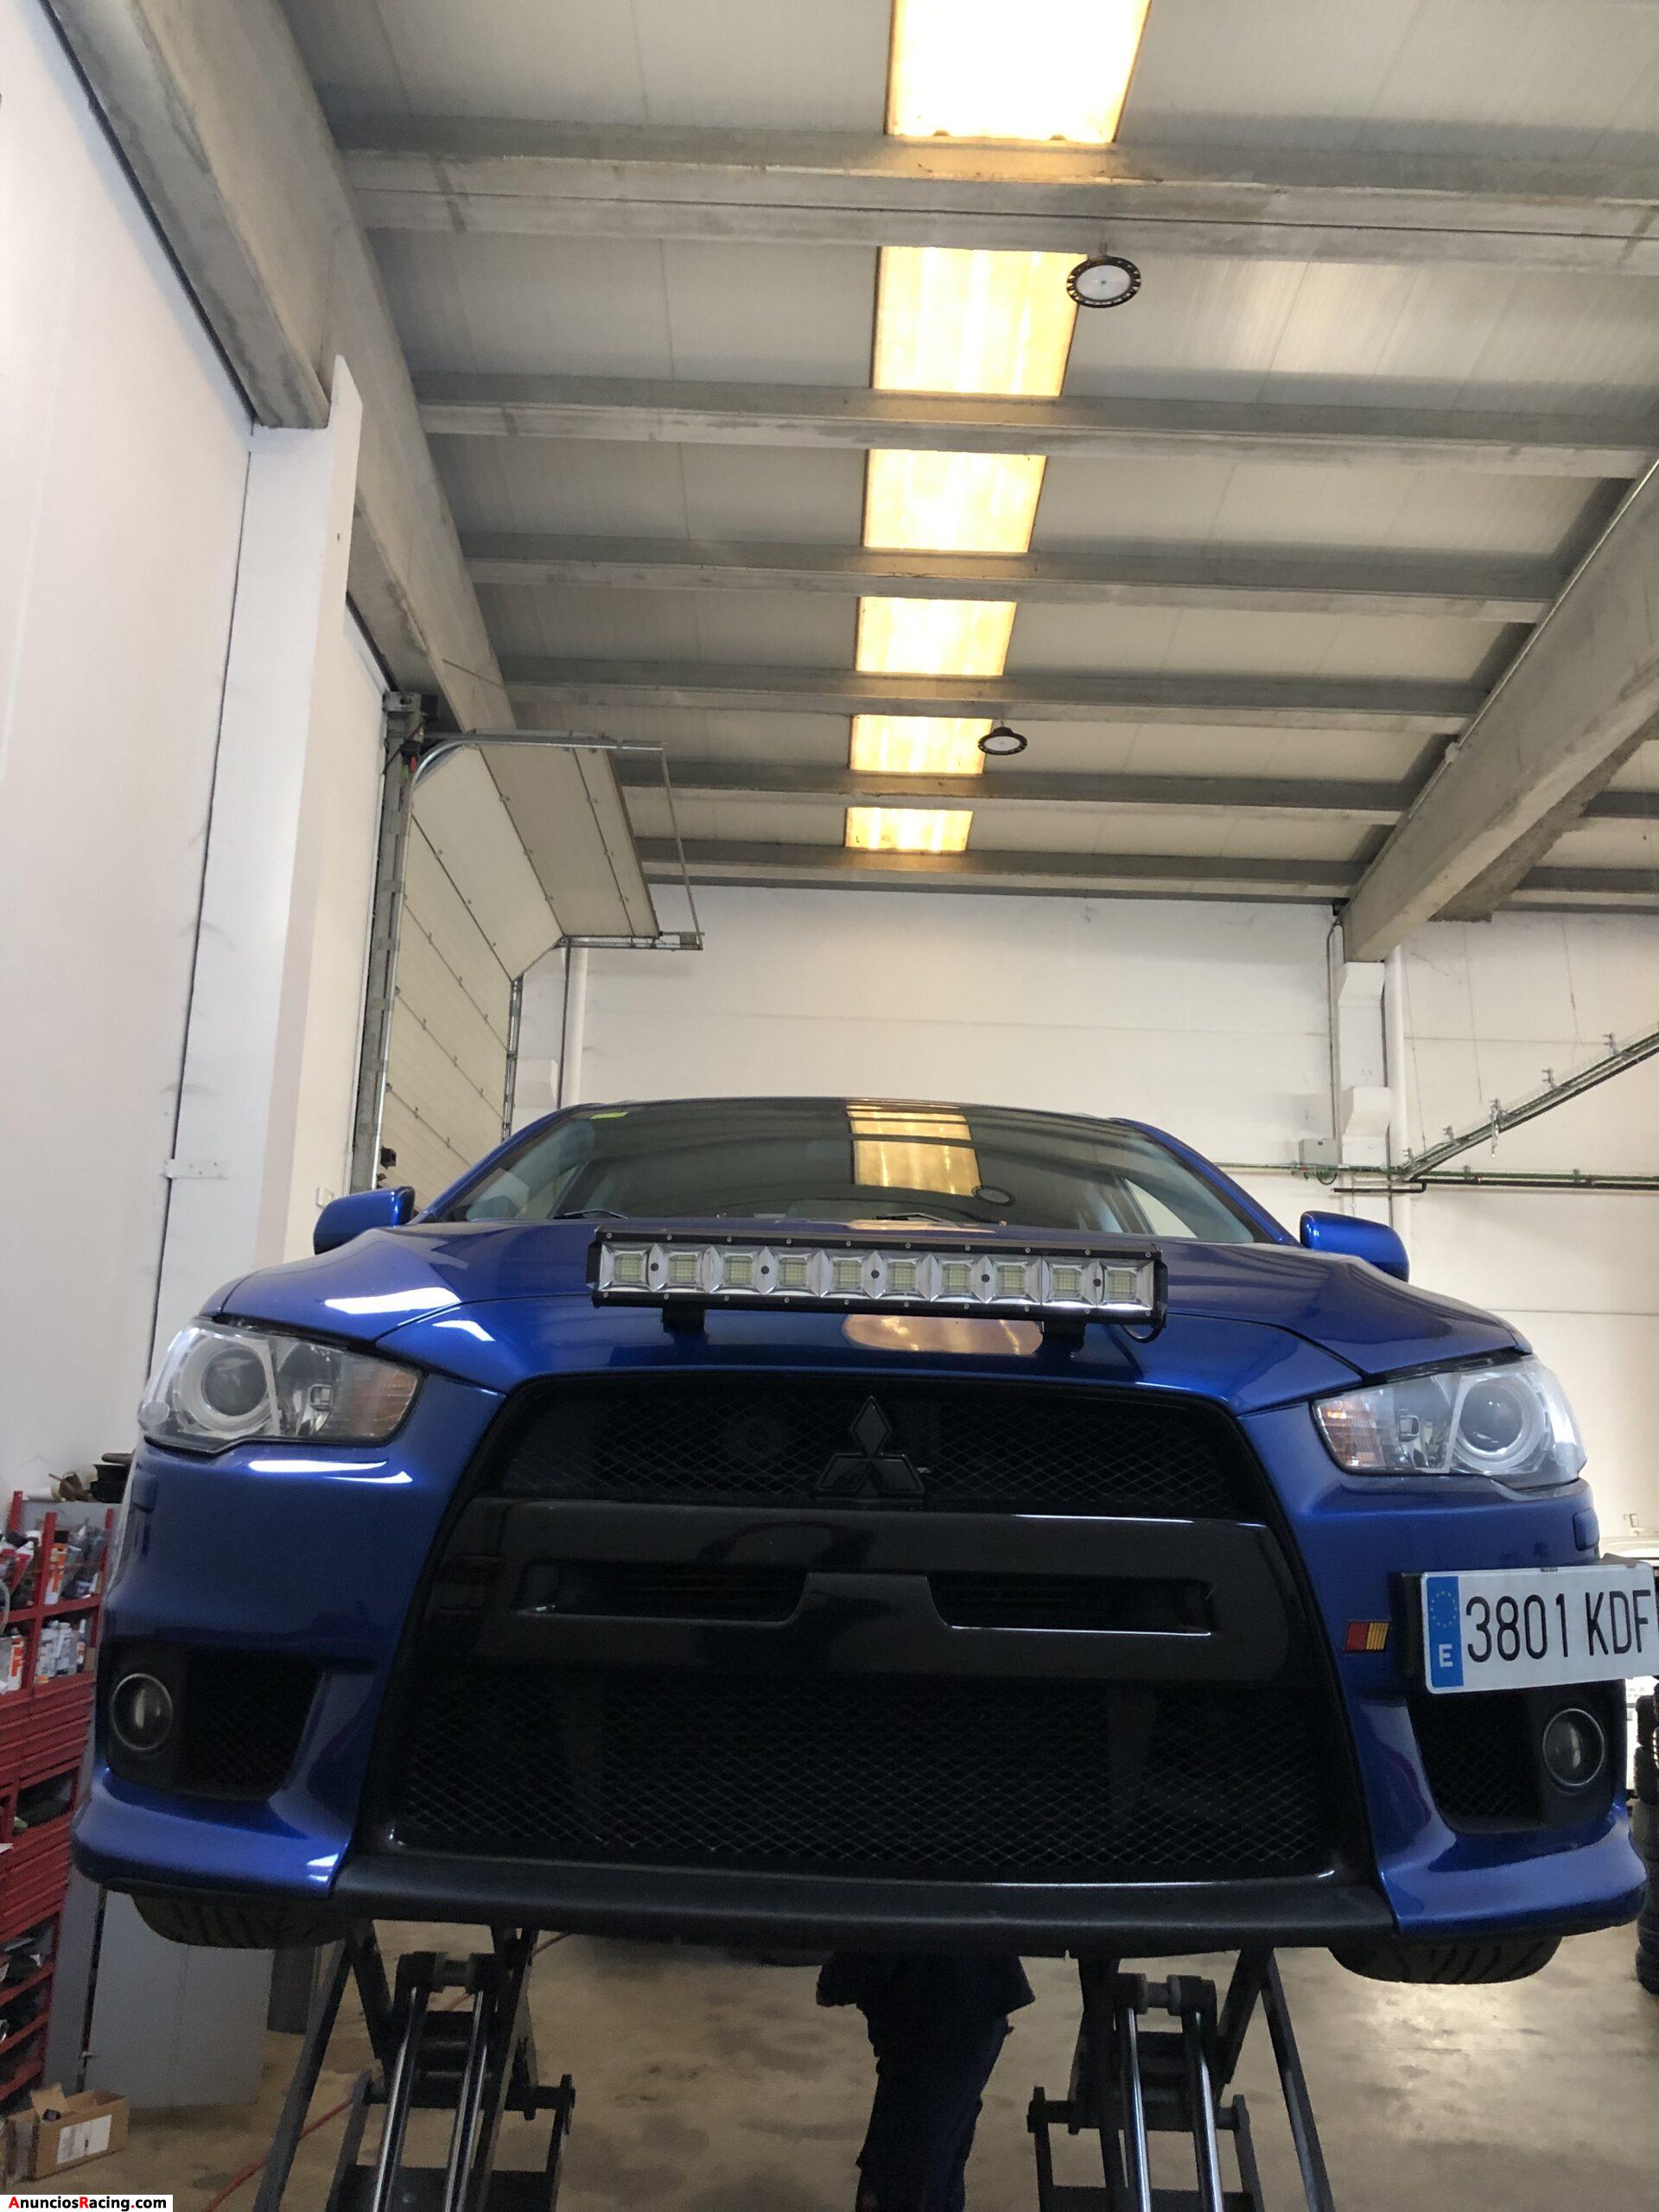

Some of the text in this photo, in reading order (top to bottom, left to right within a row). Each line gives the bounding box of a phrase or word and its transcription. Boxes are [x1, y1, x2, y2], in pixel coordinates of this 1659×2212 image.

[1465, 1589, 1652, 1662] 3801 KDF
[1438, 1643, 1453, 1668] E
